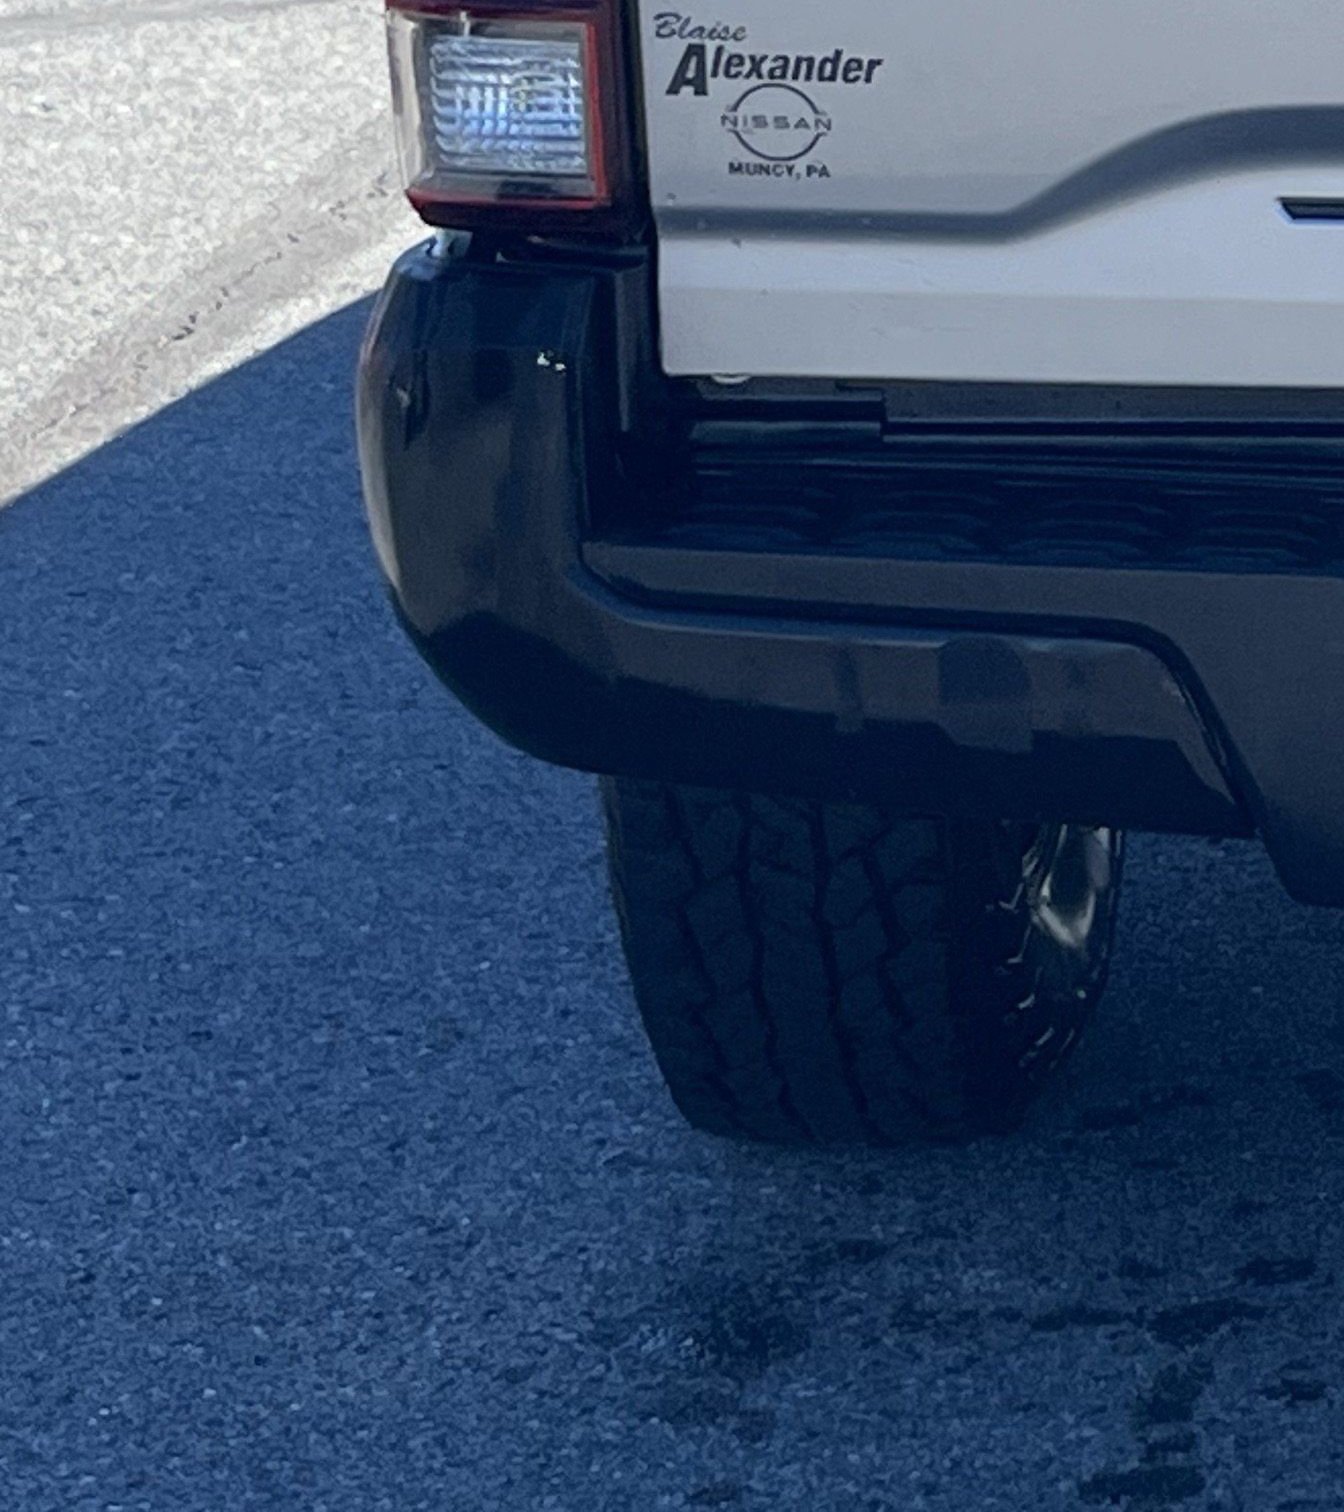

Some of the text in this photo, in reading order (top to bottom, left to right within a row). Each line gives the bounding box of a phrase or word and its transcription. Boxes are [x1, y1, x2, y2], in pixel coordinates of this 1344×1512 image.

[653, 11, 749, 41] Blaise
[665, 42, 884, 97] Alexander
[720, 113, 832, 132] NISSAN
[728, 161, 831, 180] MUNCY, PA
